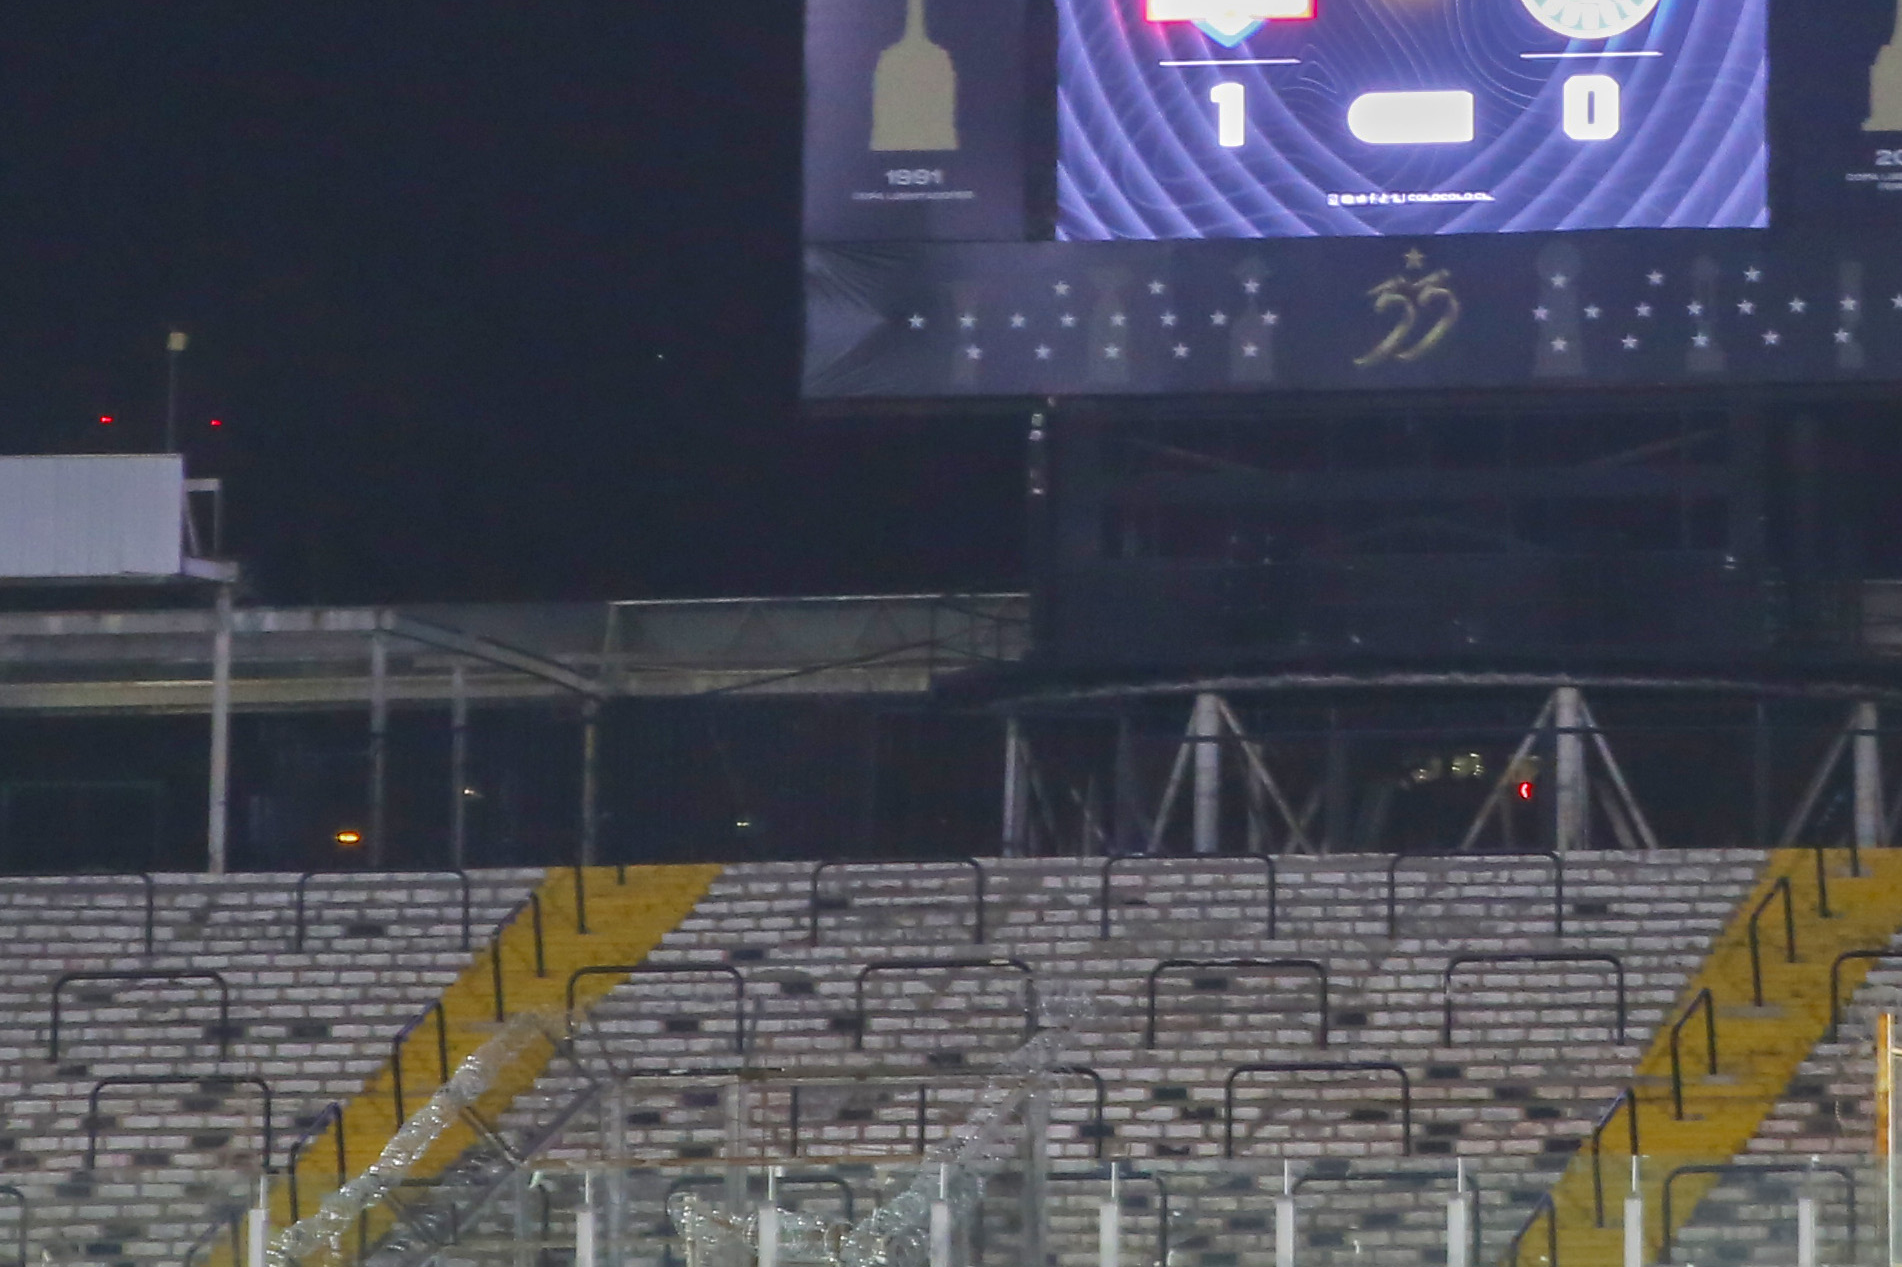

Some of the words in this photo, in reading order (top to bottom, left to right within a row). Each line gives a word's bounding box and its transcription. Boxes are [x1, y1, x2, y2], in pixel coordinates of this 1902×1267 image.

[1210, 82, 1245, 147] 1
[1563, 74, 1620, 140] 0
[884, 168, 943, 186] 1991
